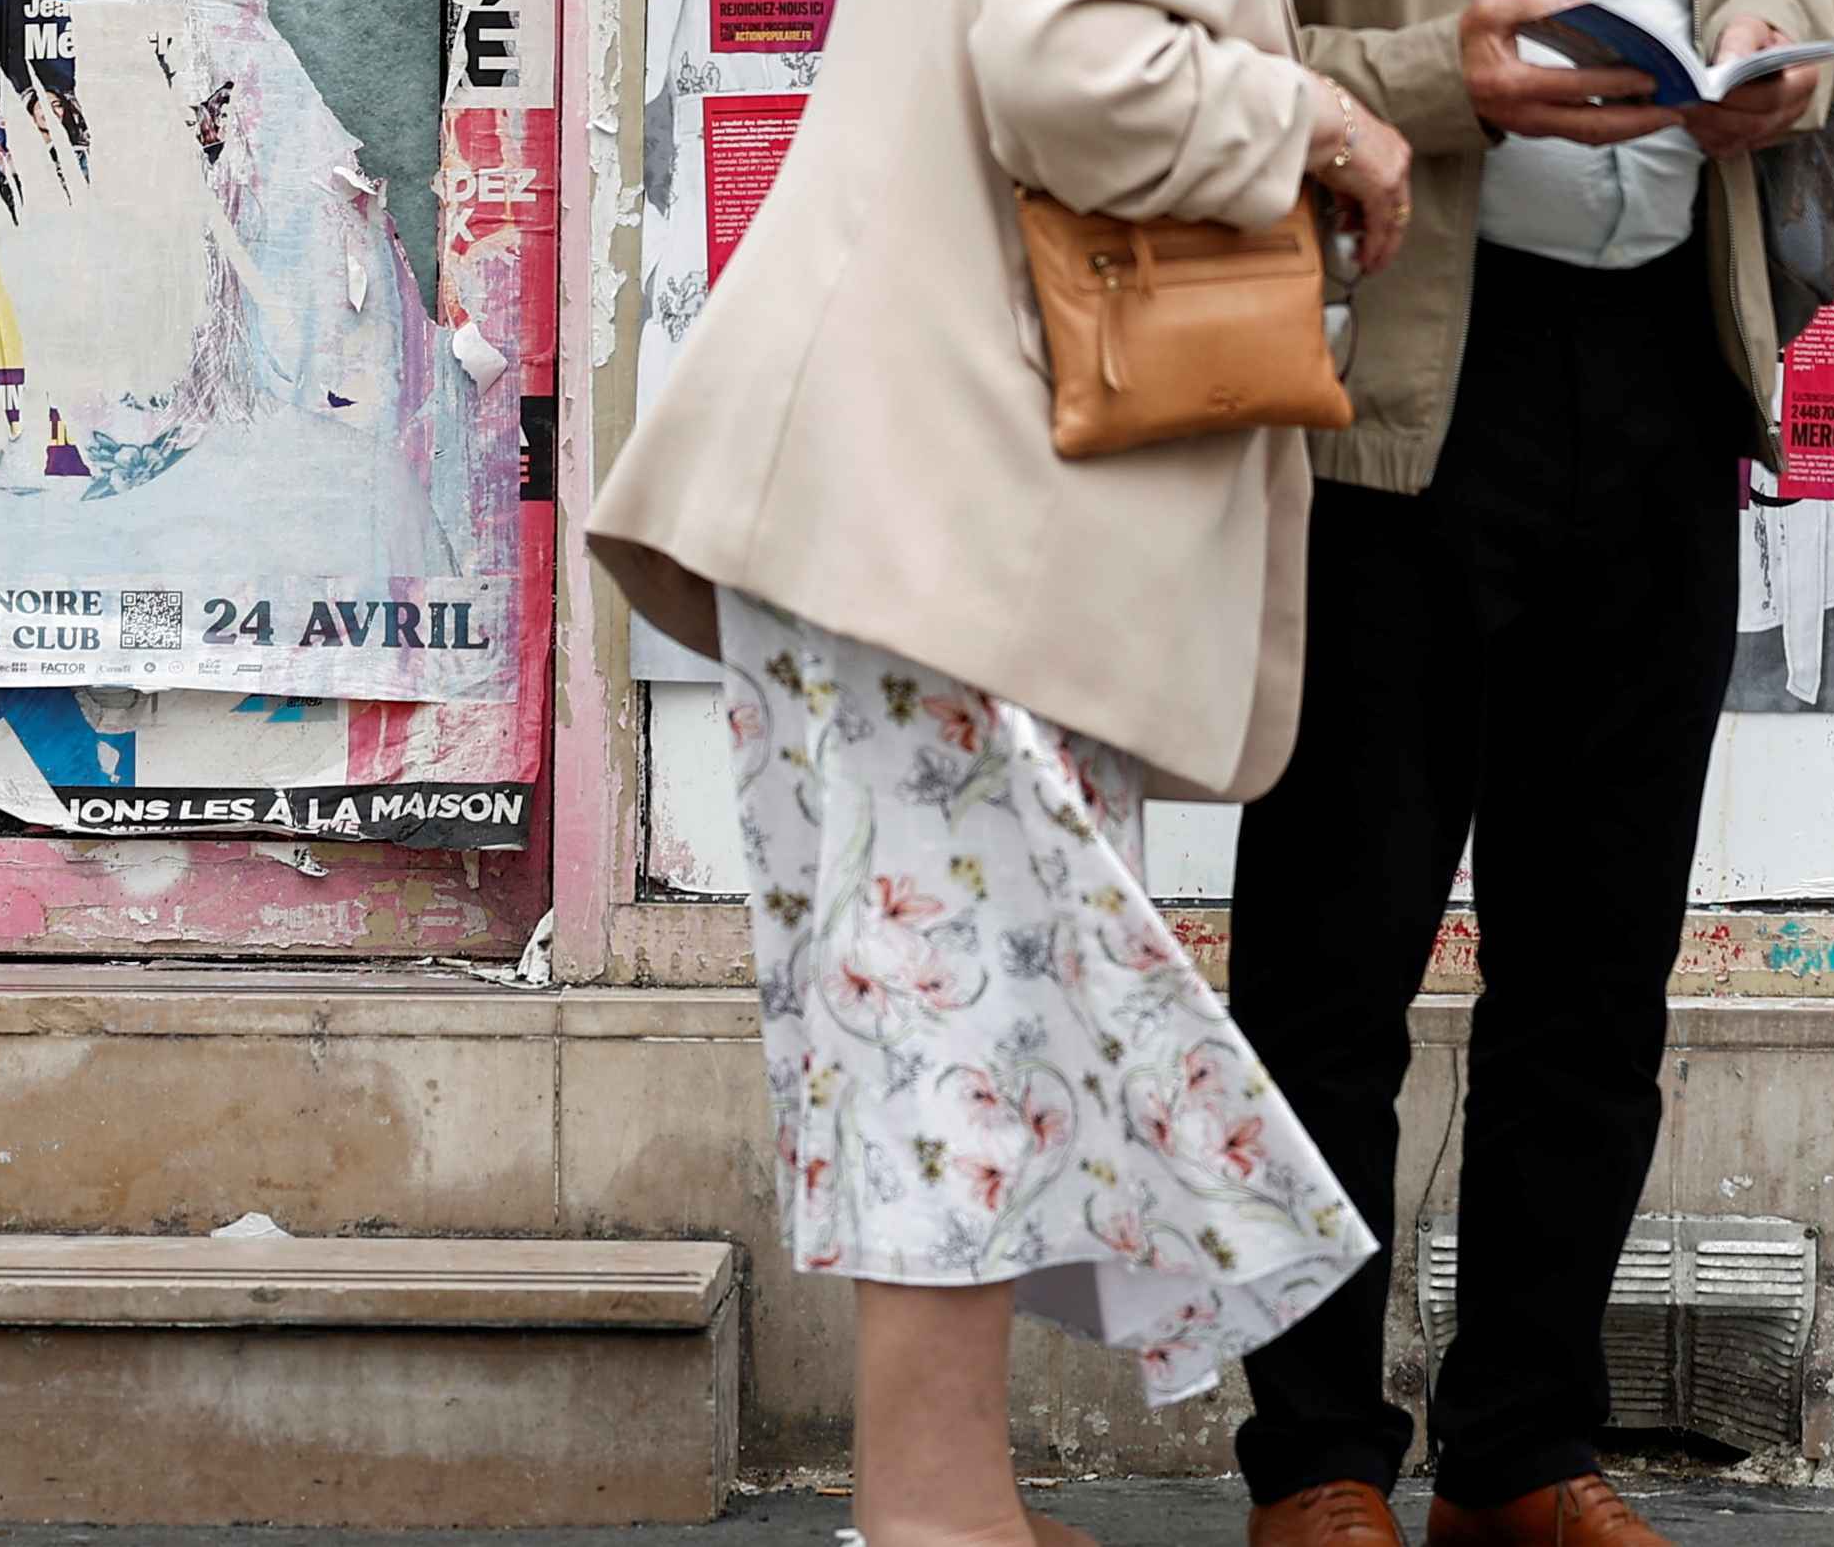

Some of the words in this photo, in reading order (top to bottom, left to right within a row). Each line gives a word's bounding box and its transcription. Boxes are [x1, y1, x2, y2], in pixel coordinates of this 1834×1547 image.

[13, 624, 101, 651] CLUB
[203, 598, 274, 647] 24
[300, 601, 490, 651] AVRIL
[179, 799, 257, 822] LES
[264, 786, 299, 825] À
[371, 792, 524, 825] MAISON
